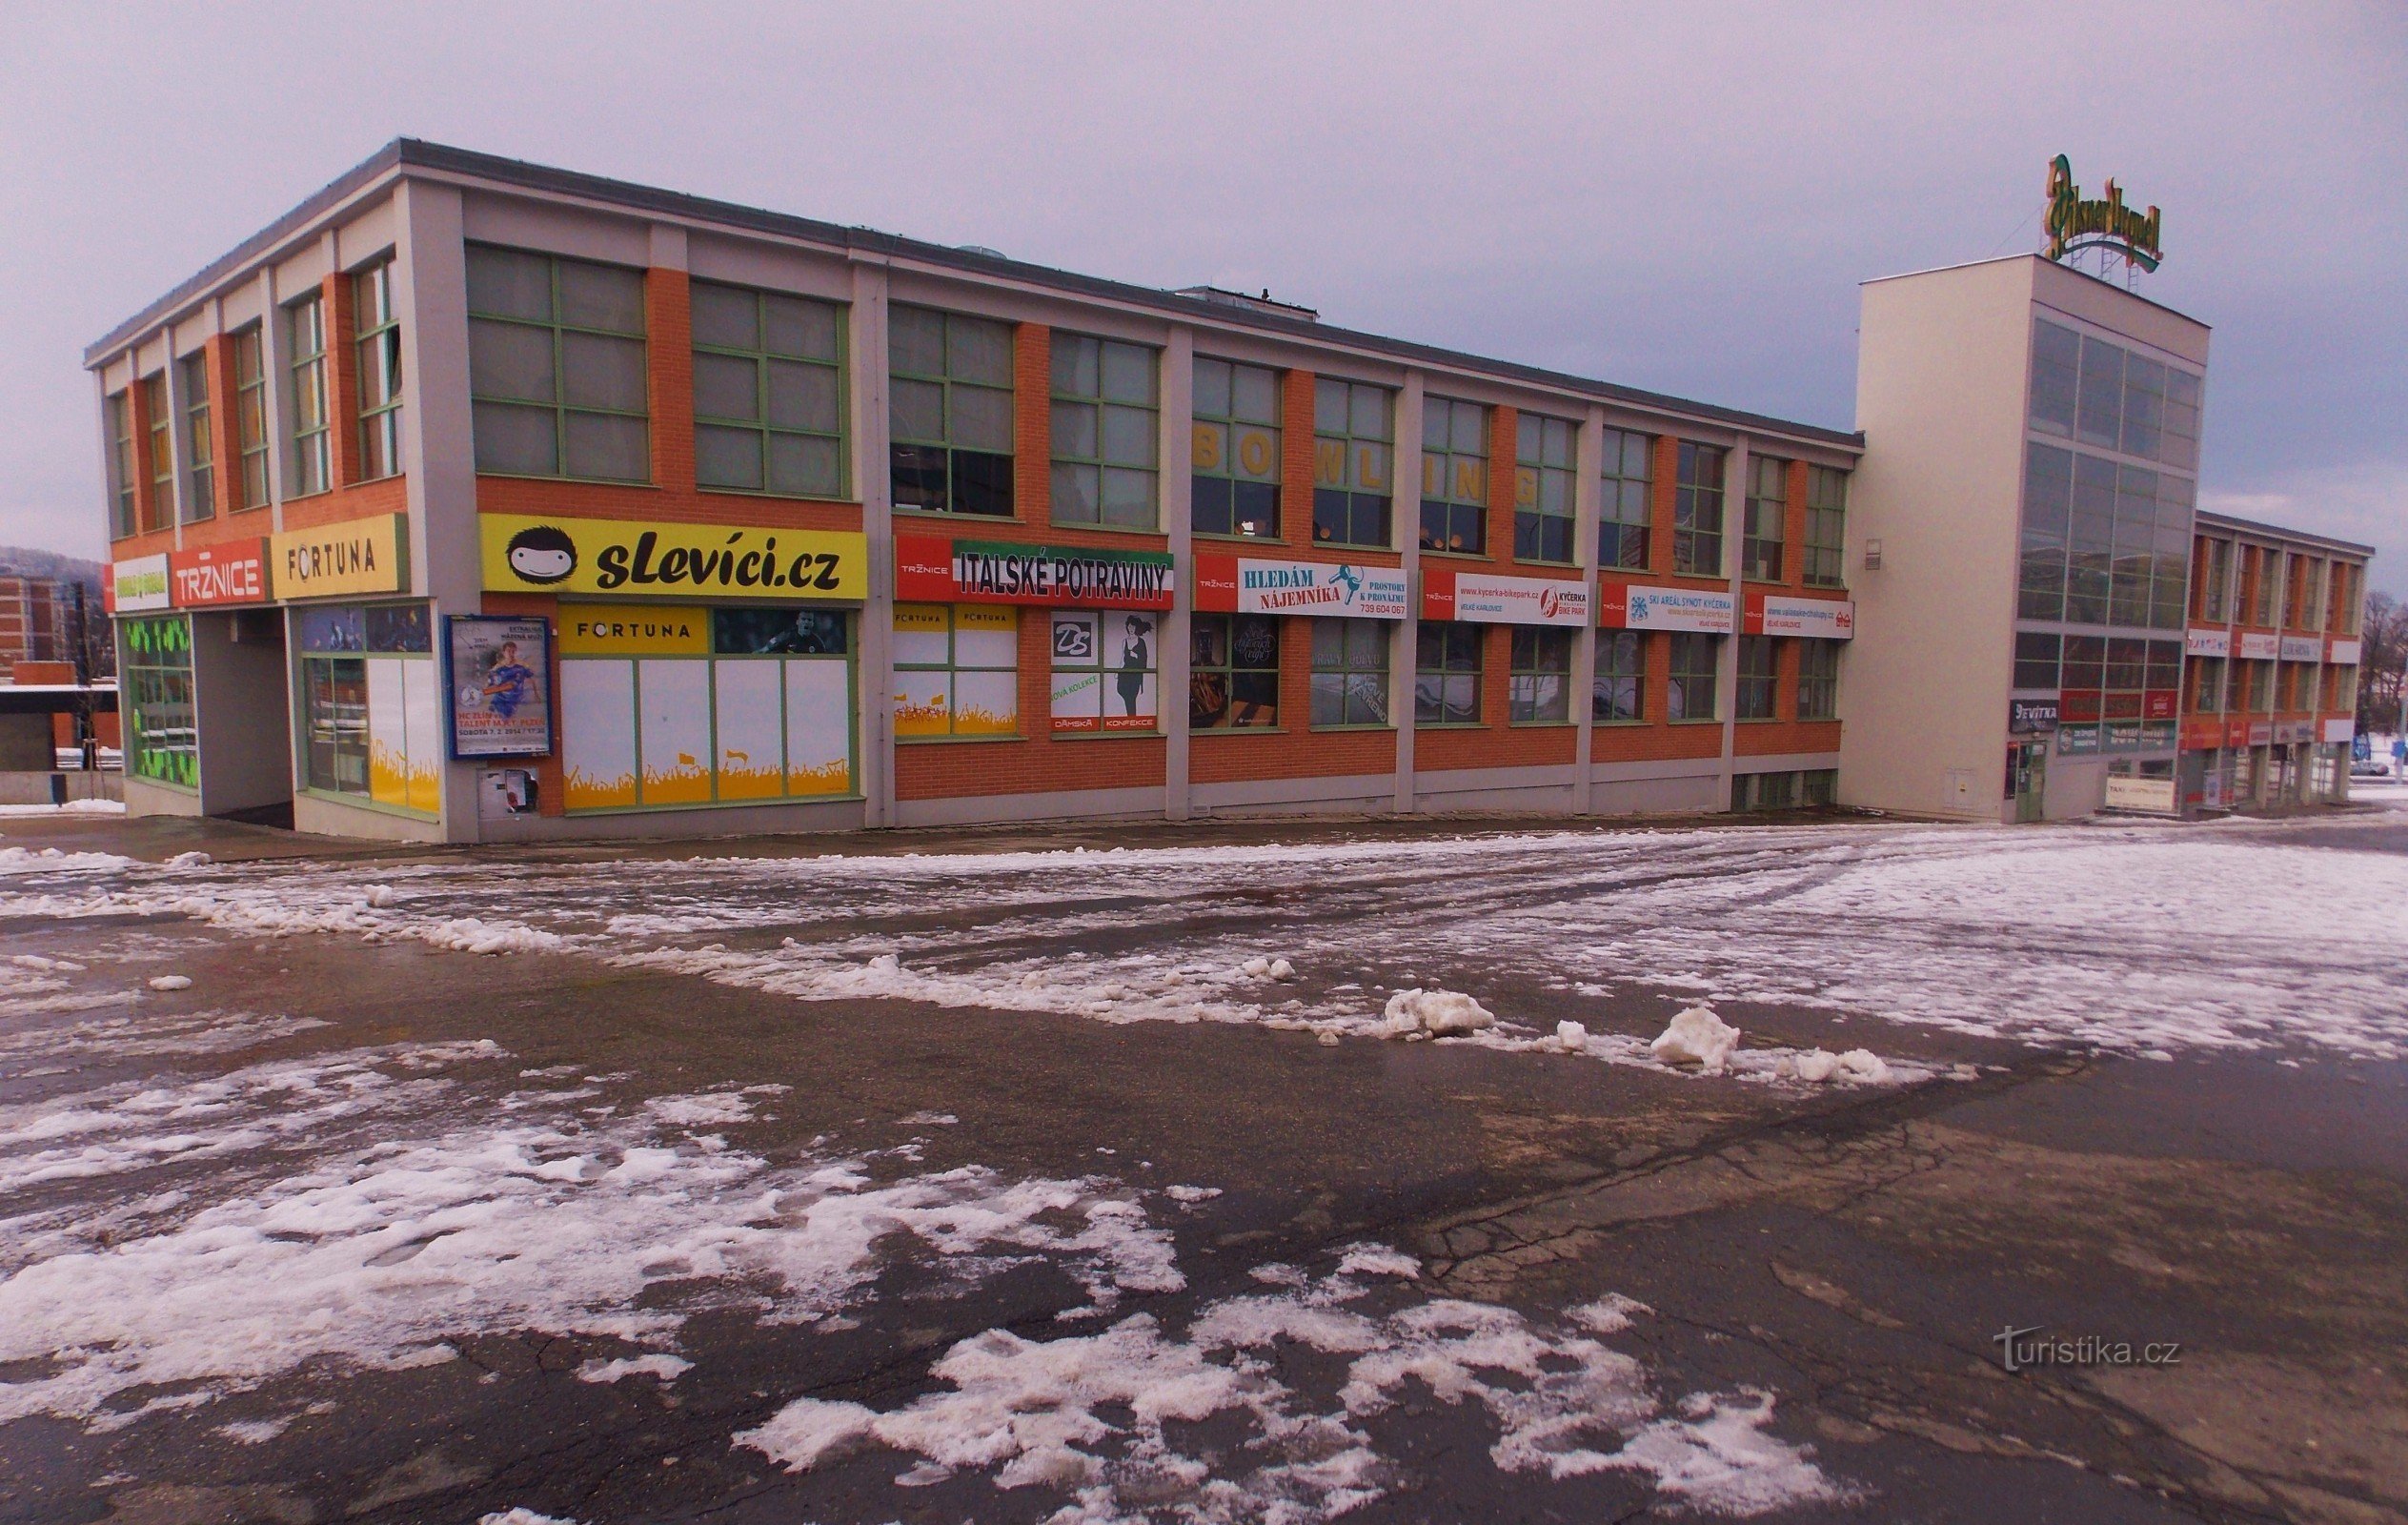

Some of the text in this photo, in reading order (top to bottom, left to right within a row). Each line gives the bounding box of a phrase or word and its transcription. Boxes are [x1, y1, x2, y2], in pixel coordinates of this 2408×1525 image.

[1191, 425, 1537, 505] BOWLING
[288, 538, 375, 582] FORTUNA
[901, 563, 949, 575] TRŽNICE
[960, 546, 1167, 601] ITALSKÉ POTRAVINY
[176, 551, 260, 601] TRŽNICE
[1244, 566, 1314, 589] HLEDÁM
[1200, 579, 1236, 589] TRŽNICE
[1369, 581, 1406, 593] PROSTORY
[1260, 585, 1341, 610] NÁJEMNÍKA
[1360, 592, 1406, 603] K PRONÁJMU
[1426, 592, 1453, 601] TRŽNICE
[1460, 587, 1539, 600] www.kycerka-bikepark.cz
[1559, 591, 1587, 602] KYČERKA
[1476, 604, 1503, 613] KARLOVICE
[1649, 595, 1731, 610] SKI AREÁL SYNOT KYČERKA
[1361, 603, 1406, 615] 739 604 067
[964, 613, 1006, 622] FORTUNA
[577, 622, 691, 638] FORTUNA
[1068, 675, 1099, 694] KOLEKCE
[1054, 718, 1154, 727] DÁMSKÁ KONFEKCE
